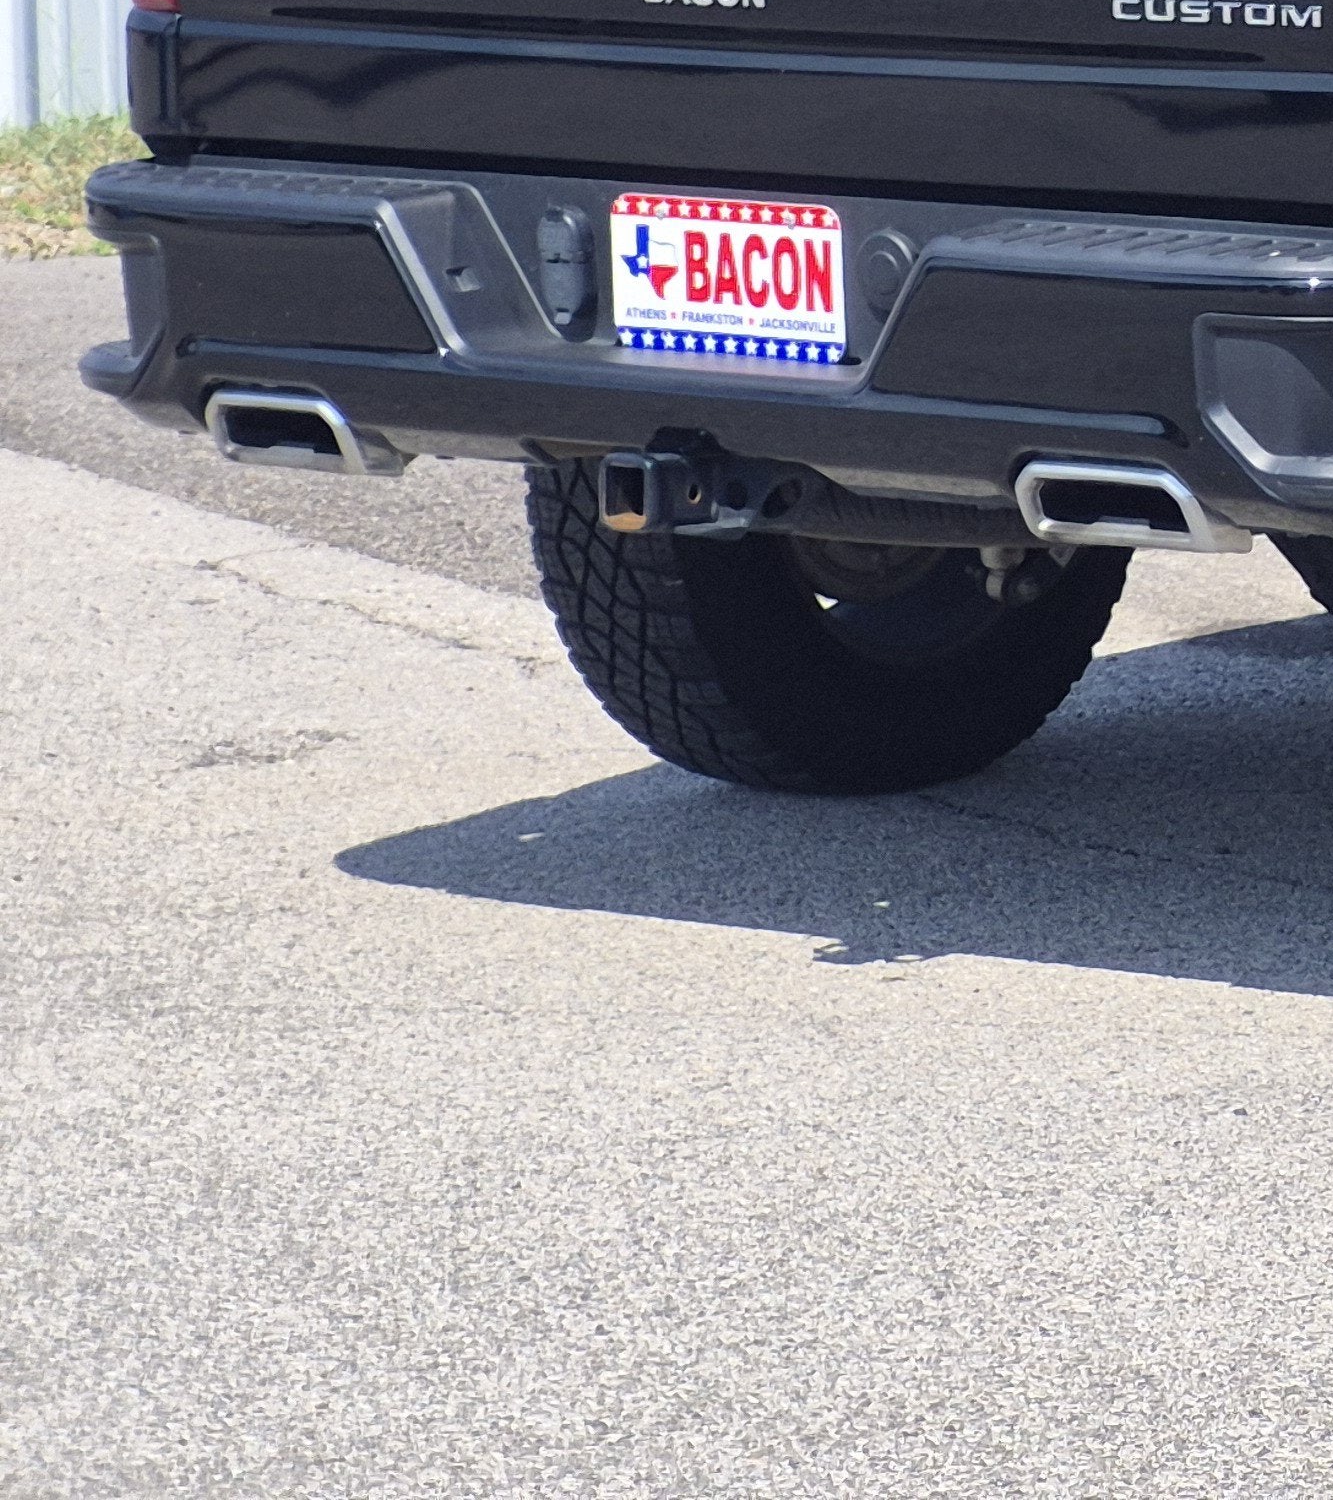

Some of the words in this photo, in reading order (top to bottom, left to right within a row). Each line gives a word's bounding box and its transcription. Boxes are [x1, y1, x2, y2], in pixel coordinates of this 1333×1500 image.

[683, 230, 834, 315] BACON
[625, 306, 667, 322] ATHENS
[681, 310, 743, 326] FRANKSTON
[758, 316, 836, 334] JACKSONVILLE
